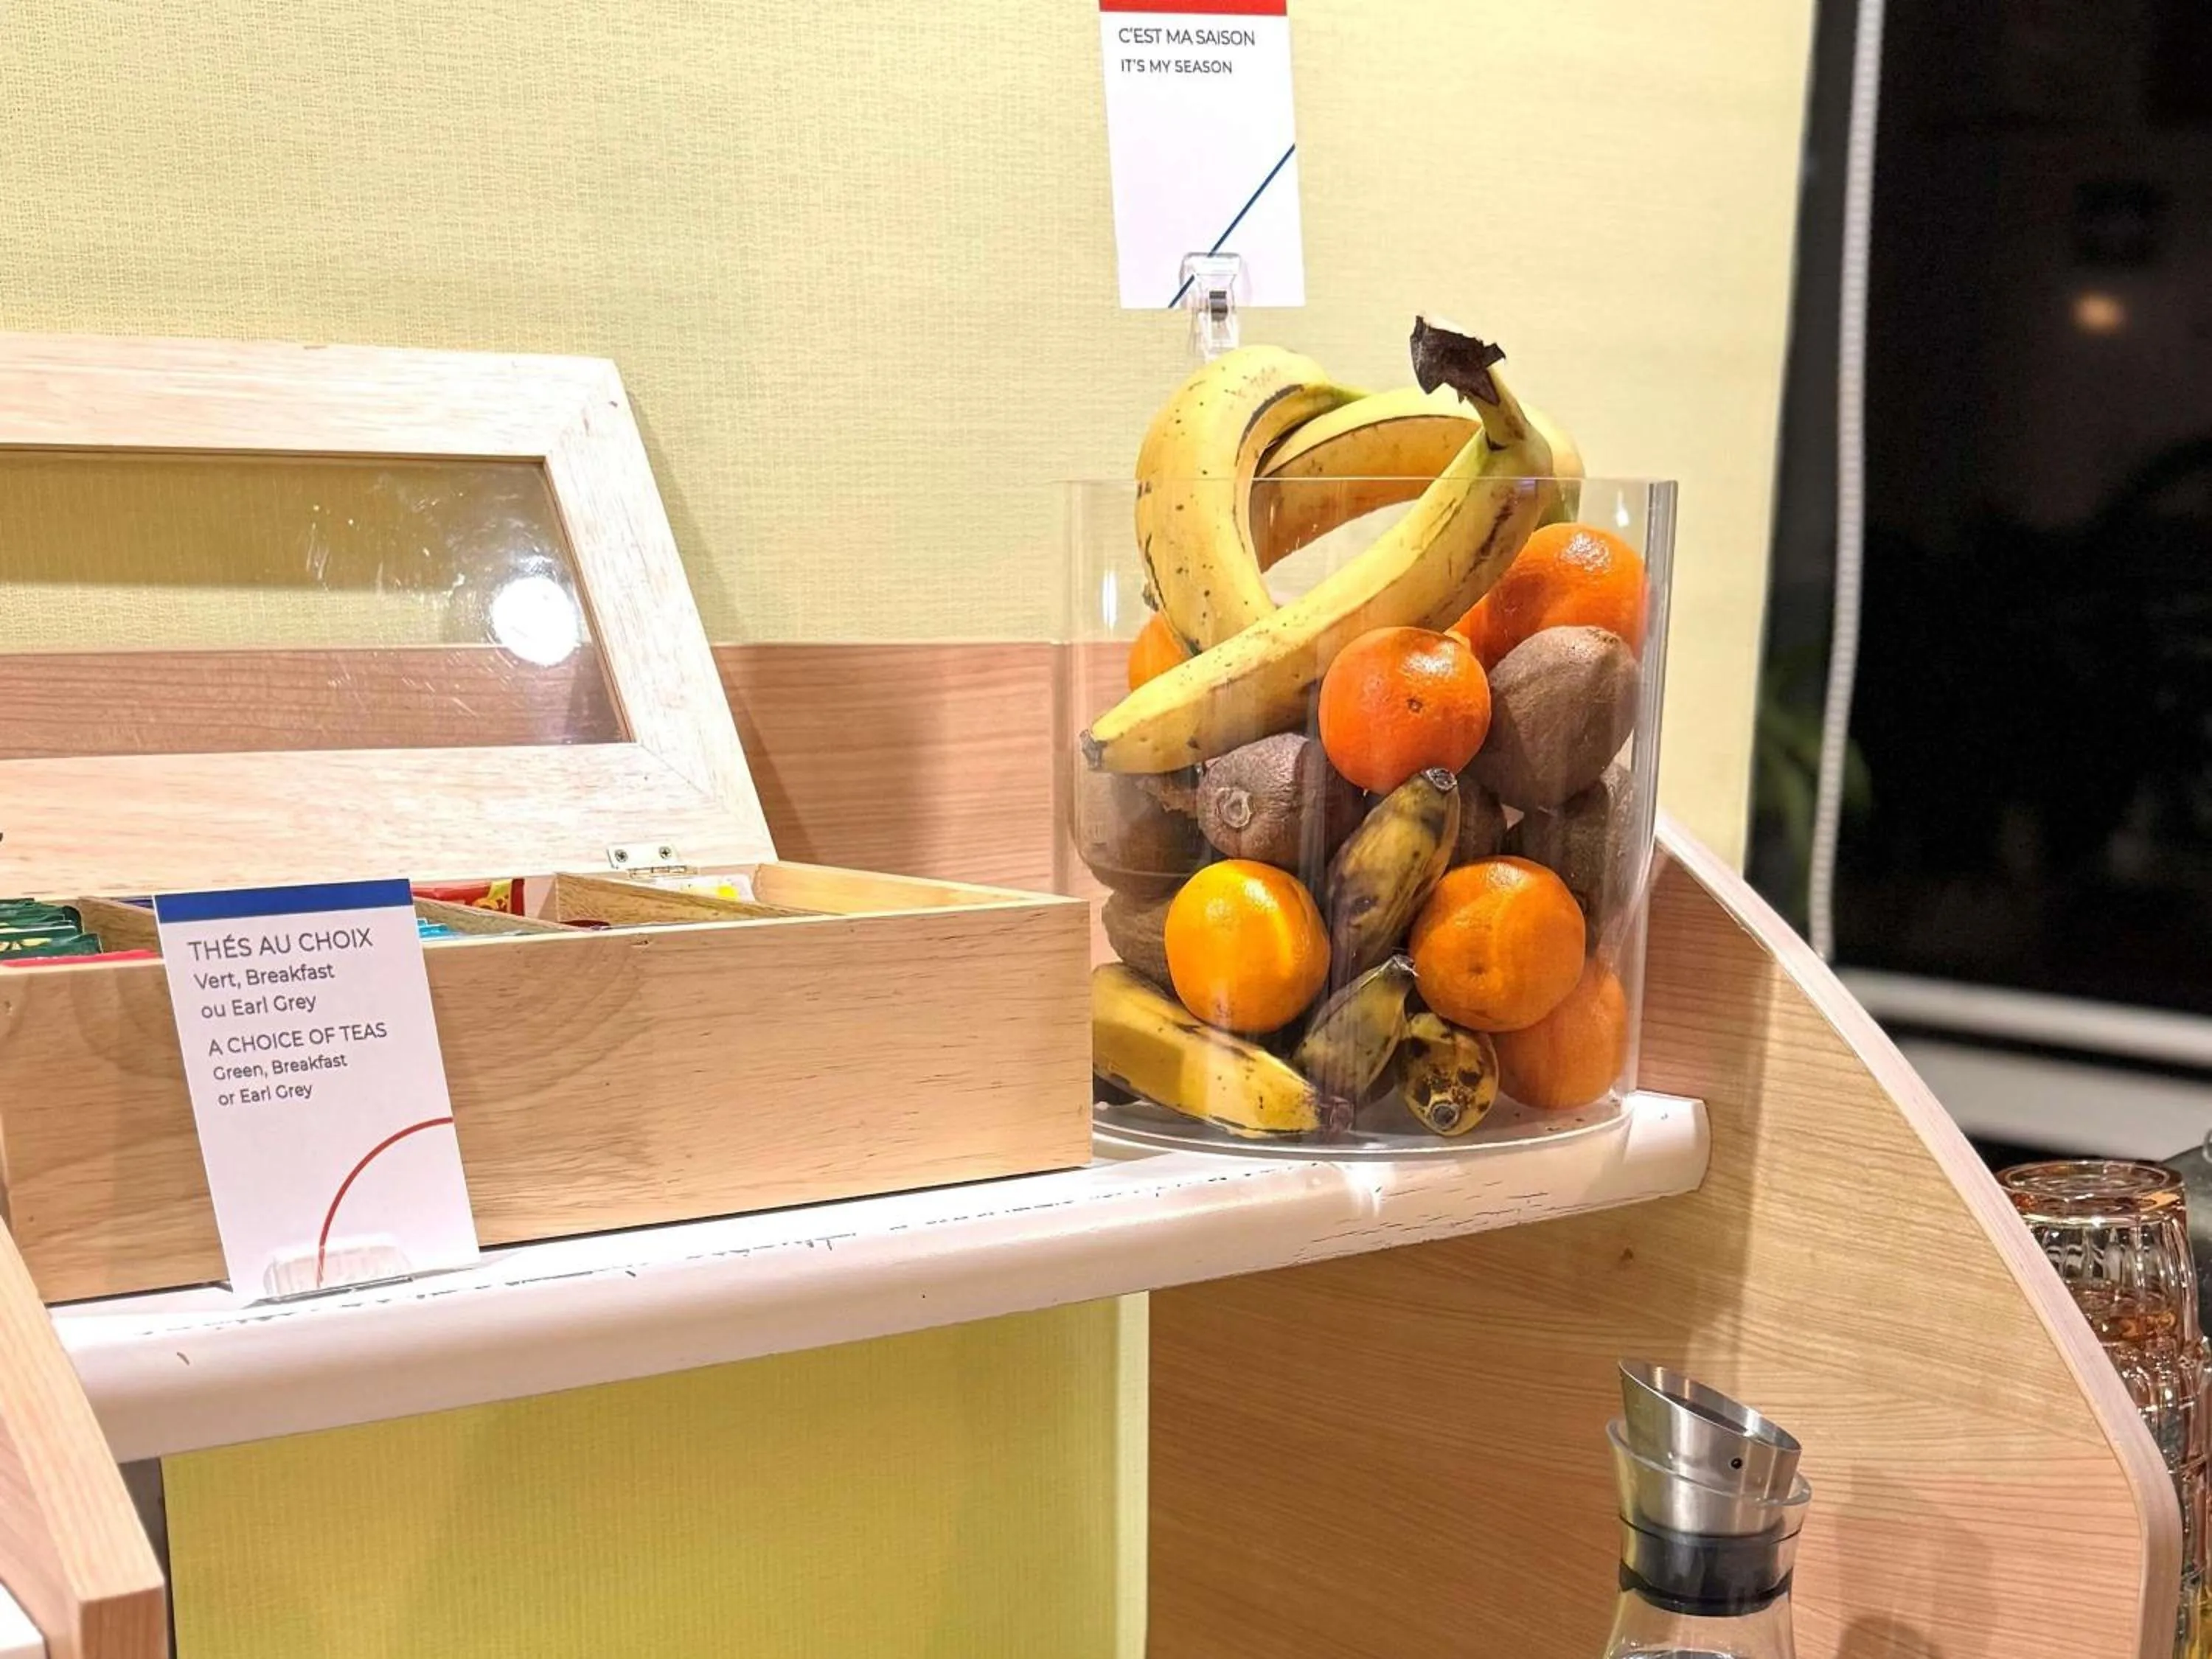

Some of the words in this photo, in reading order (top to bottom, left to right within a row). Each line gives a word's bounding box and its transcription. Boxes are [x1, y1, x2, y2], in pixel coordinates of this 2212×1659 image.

[1118, 27, 1163, 44] C'EST
[1166, 29, 1194, 46] MA
[1195, 29, 1256, 46] SAISON
[1121, 58, 1146, 73] IT'S
[1149, 59, 1171, 74] MY
[1175, 59, 1233, 74] SEASON
[187, 933, 253, 961] THÉS
[259, 933, 292, 956] AU
[297, 928, 374, 953] CHOIX
[193, 972, 242, 991] Vert,
[245, 963, 335, 987] Breakfast
[201, 1004, 227, 1019] ou
[231, 995, 269, 1017] Earl
[273, 995, 317, 1014] Grey
[208, 1038, 224, 1057] A
[226, 1029, 305, 1054] CHOICE
[308, 1026, 336, 1046] OF
[338, 1022, 388, 1043] TEAS
[212, 1064, 268, 1082] Green,
[271, 1054, 349, 1075] Breakfast
[218, 1093, 236, 1107] or
[239, 1085, 272, 1104] Earl
[274, 1084, 314, 1100] Grey
